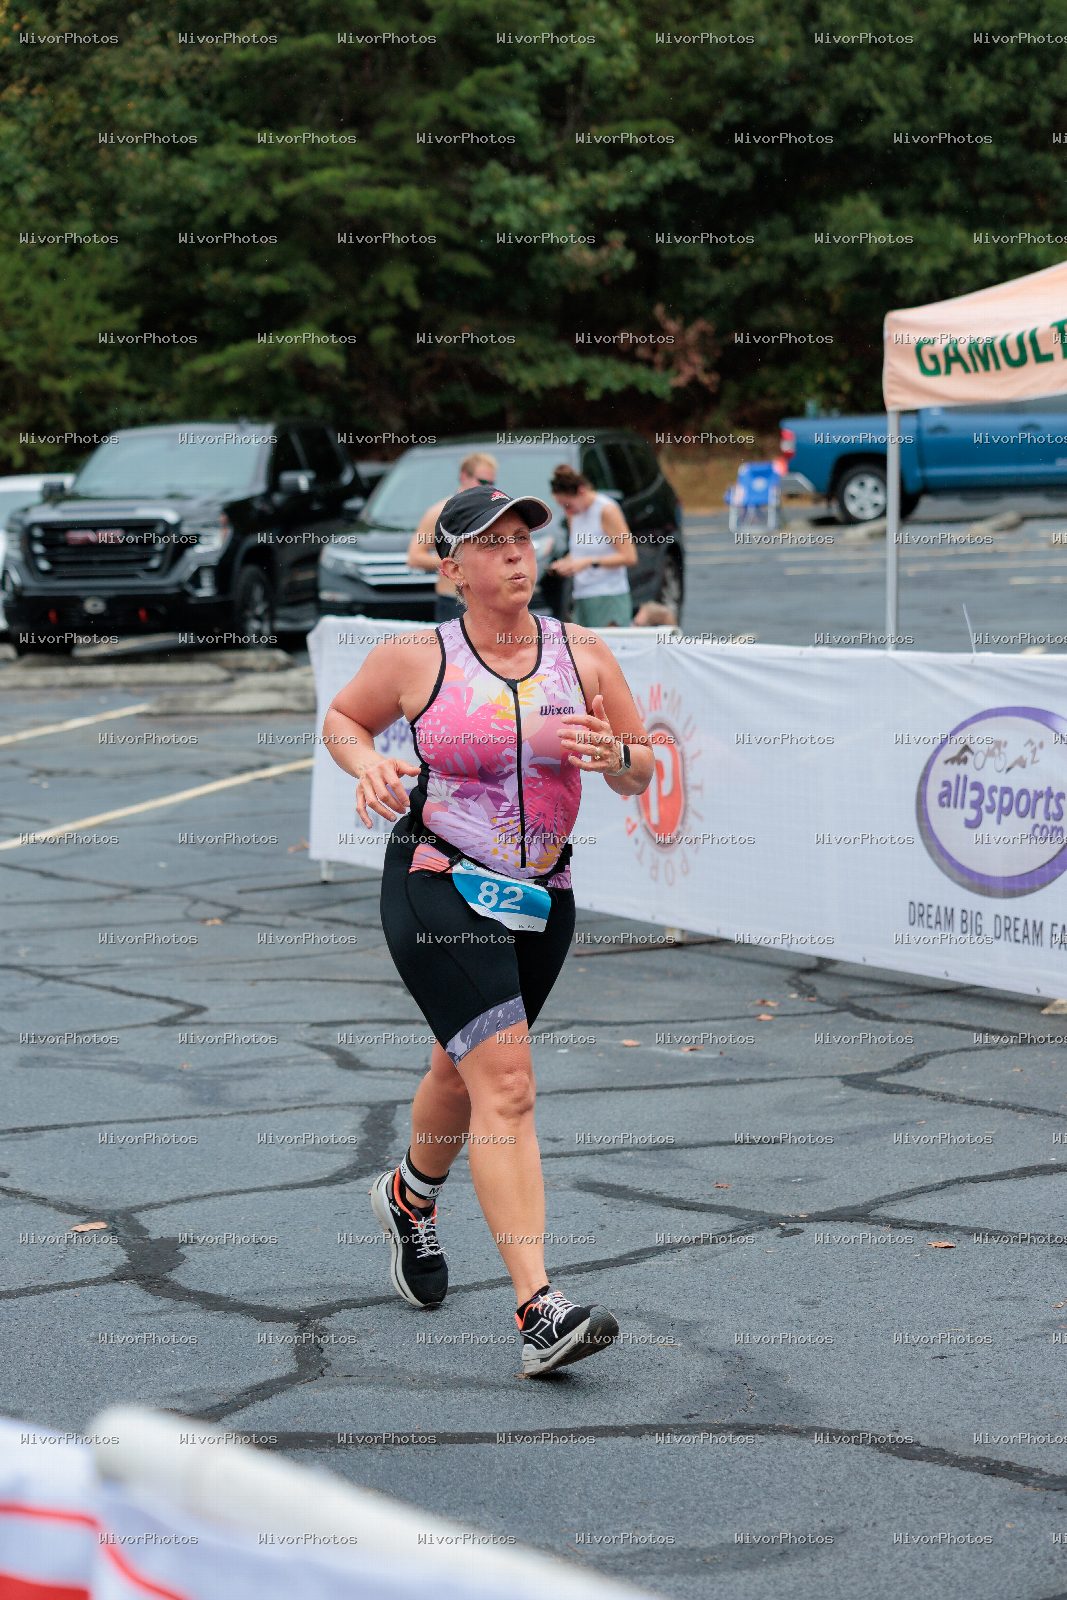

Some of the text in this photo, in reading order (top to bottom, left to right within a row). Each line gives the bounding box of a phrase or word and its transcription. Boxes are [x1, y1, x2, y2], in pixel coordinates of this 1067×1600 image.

[540, 704, 576, 716] Wixen
[937, 773, 1066, 829] all3sports
[477, 880, 524, 911] 82
[908, 901, 954, 933] DREAM
[993, 913, 1044, 948] DREAM
